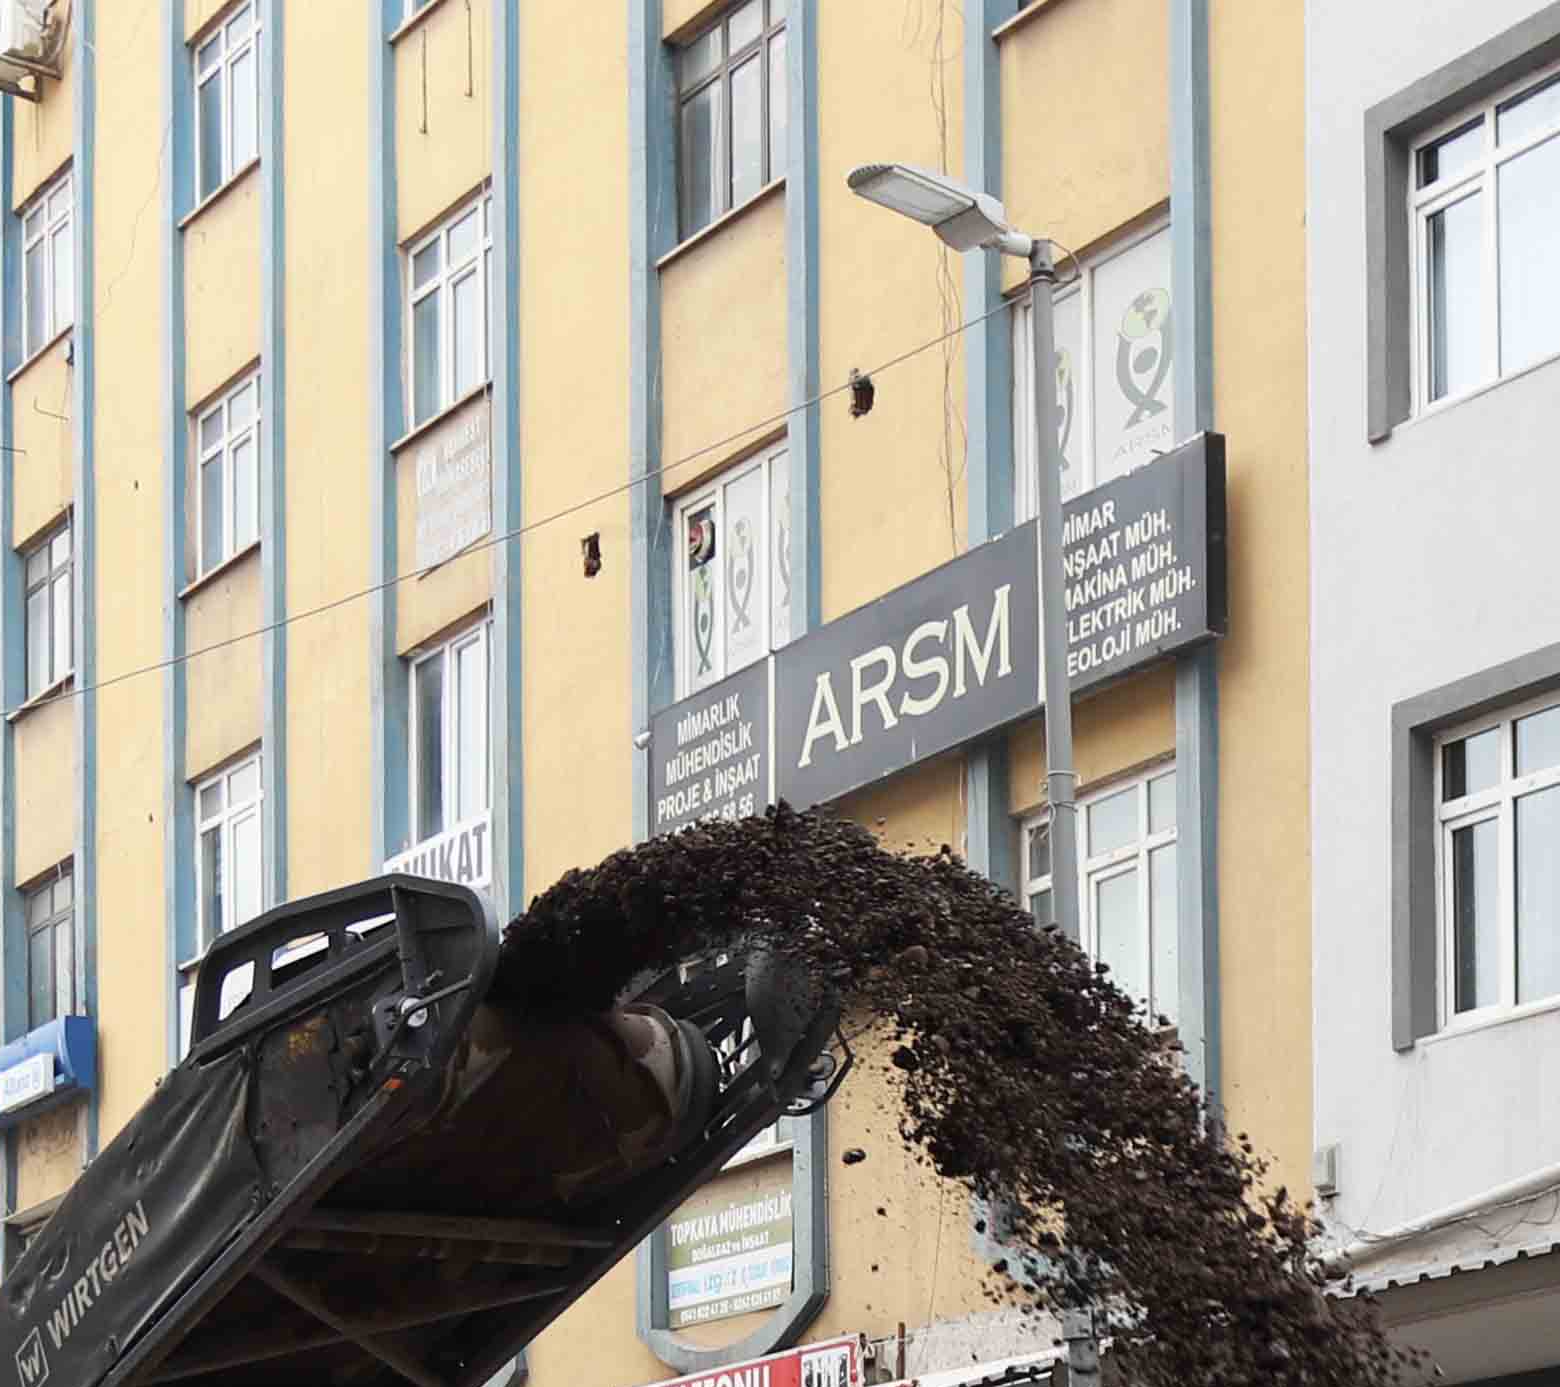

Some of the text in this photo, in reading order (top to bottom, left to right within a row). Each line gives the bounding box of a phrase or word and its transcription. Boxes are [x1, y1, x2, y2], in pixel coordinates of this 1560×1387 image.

[1064, 508, 1171, 580] NŞAAT MÜH.
[1132, 540, 1177, 582] MÜH.
[1066, 565, 1196, 644] LEKTRİK MÜH.
[797, 583, 1012, 769] ARSM
[1068, 607, 1181, 677] EOLOJİ MÜH.
[665, 721, 752, 786] MÜHENDİSLİK
[677, 693, 740, 746] MİMARLIK
[657, 783, 701, 824] PROJE
[704, 778, 713, 803] &
[715, 753, 761, 798] İNŞAAT
[671, 1216, 719, 1247] TOPKAYA
[46, 1199, 150, 1350] WIRTGEN
